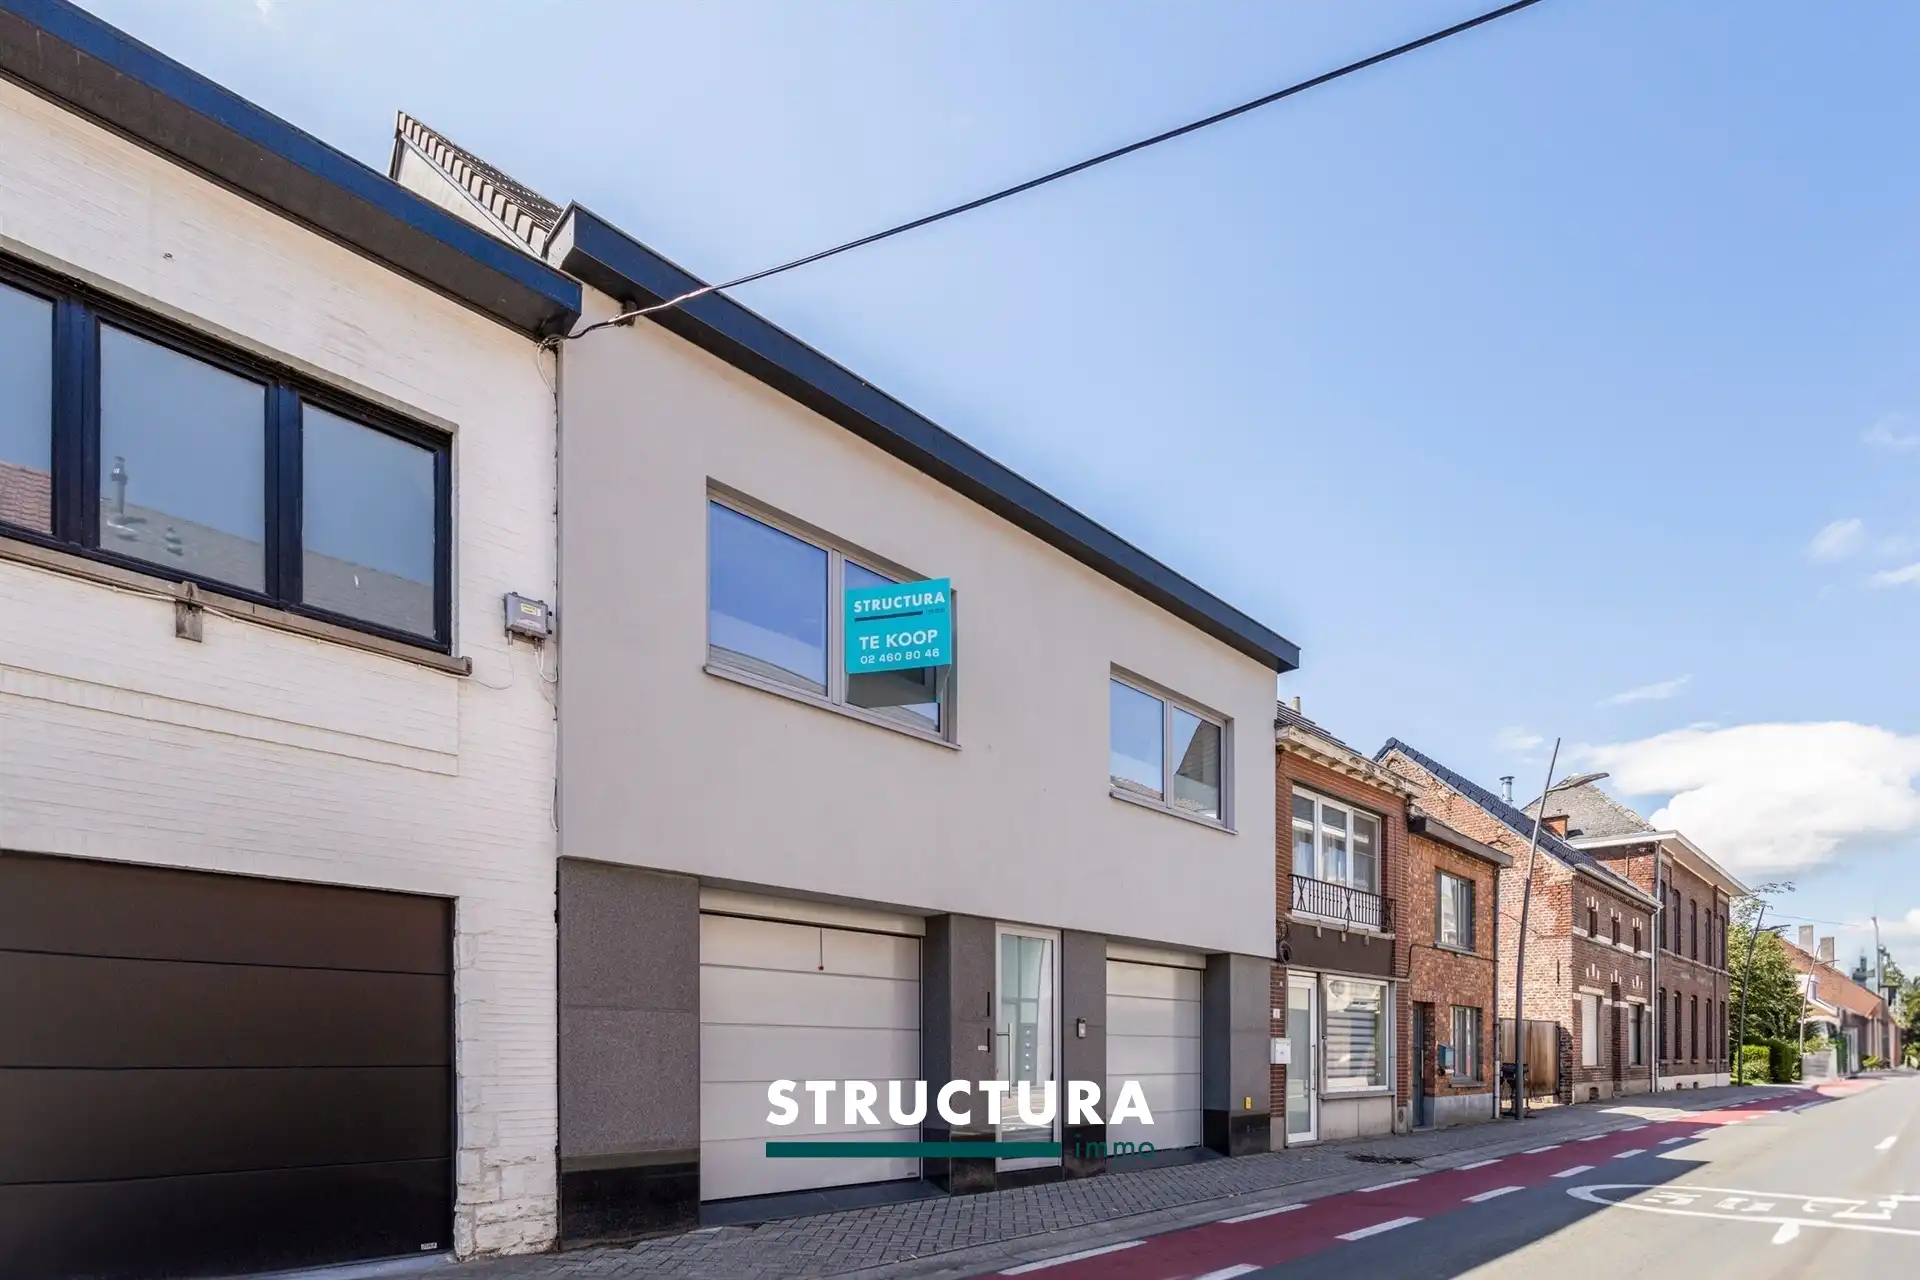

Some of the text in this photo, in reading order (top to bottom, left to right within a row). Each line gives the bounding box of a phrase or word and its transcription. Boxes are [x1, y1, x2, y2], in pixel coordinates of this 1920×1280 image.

[854, 592, 945, 613] STRUCTURA
[859, 629, 938, 650] TE KOOP
[860, 648, 940, 664] 02 460 80 46
